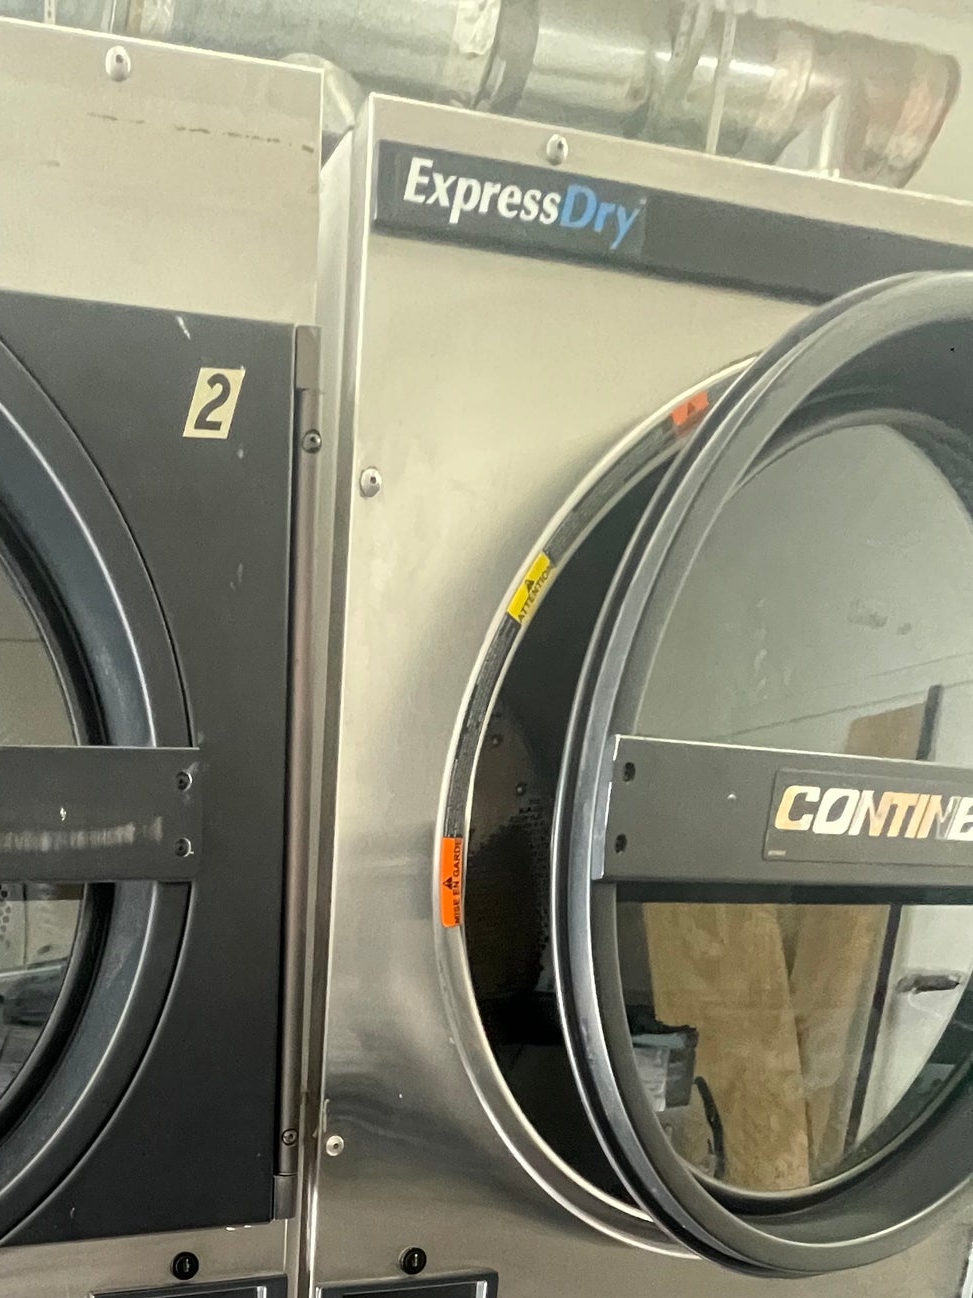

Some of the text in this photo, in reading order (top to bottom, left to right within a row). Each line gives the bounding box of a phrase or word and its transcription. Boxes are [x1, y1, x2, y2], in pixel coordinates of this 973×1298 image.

[403, 156, 641, 250] ExpressDry
[193, 373, 231, 431] 2
[452, 881, 460, 896] EN
